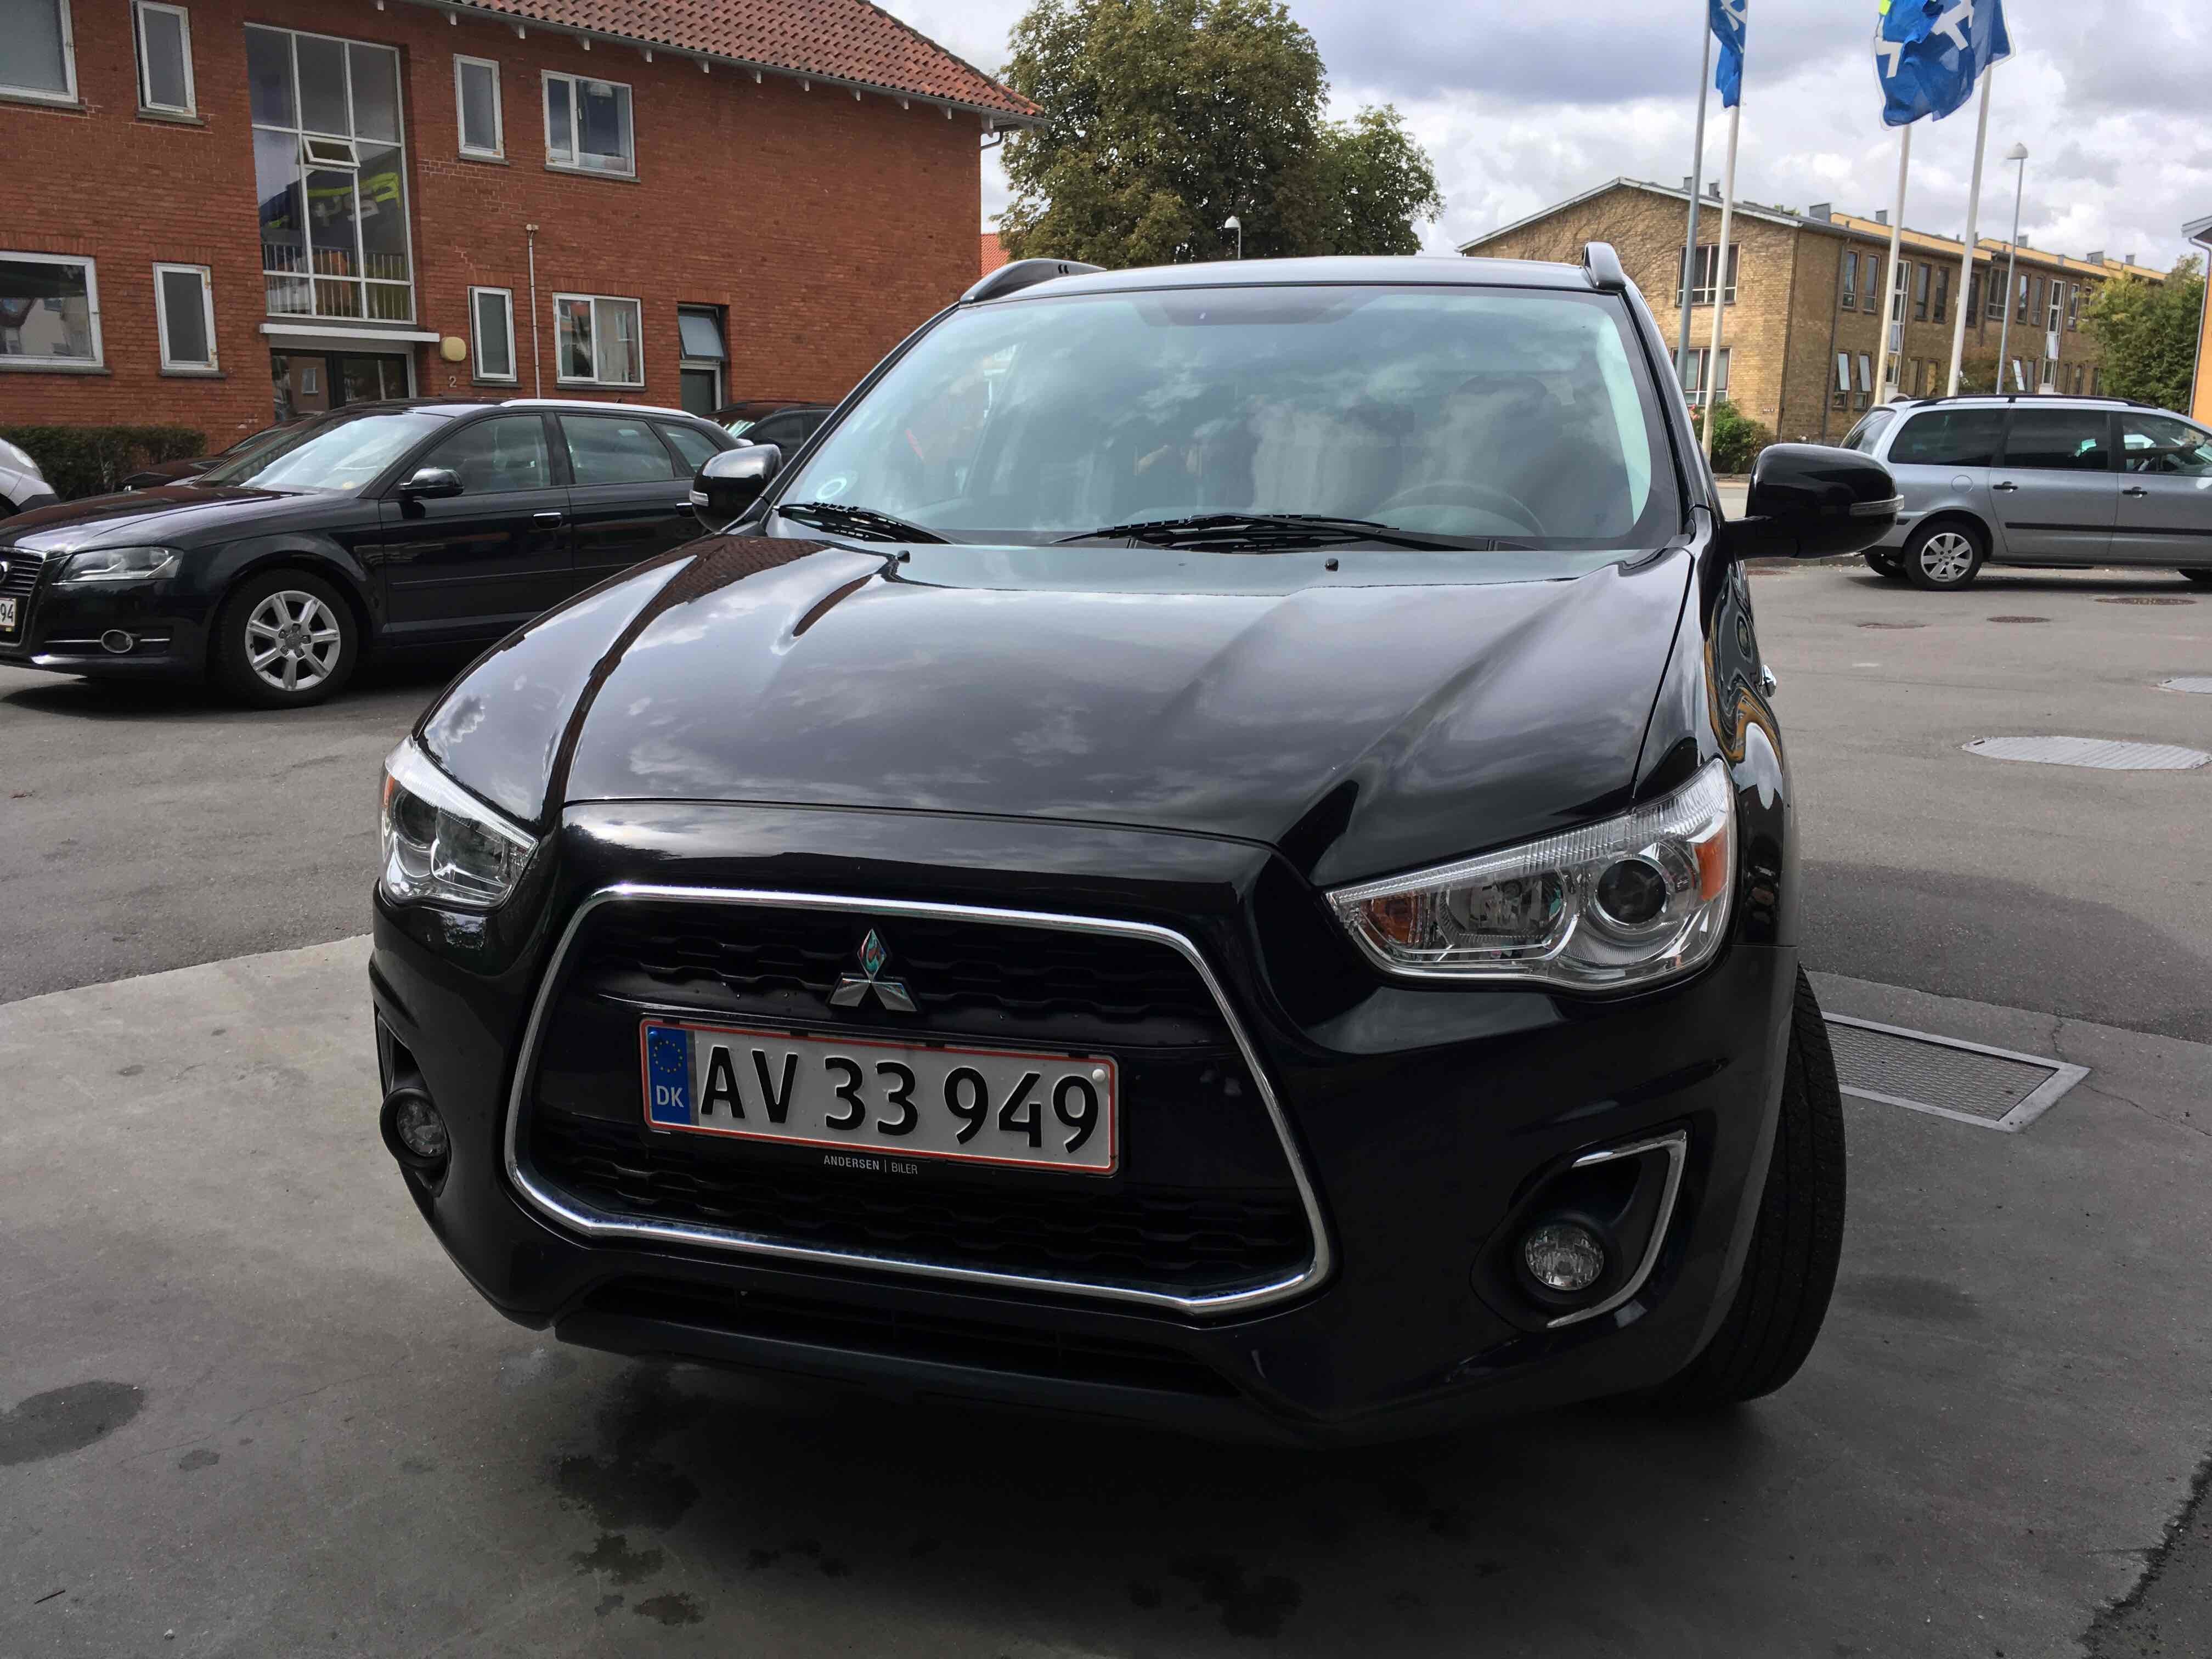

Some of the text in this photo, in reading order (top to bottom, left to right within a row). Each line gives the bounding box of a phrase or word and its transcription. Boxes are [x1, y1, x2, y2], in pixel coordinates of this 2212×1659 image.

[449, 376, 457, 388] 2
[1, 603, 14, 622] 94
[656, 1085, 684, 1108] DK
[700, 1046, 1099, 1154] AV 33 949
[823, 1155, 918, 1175] ANDERSEN BILER
